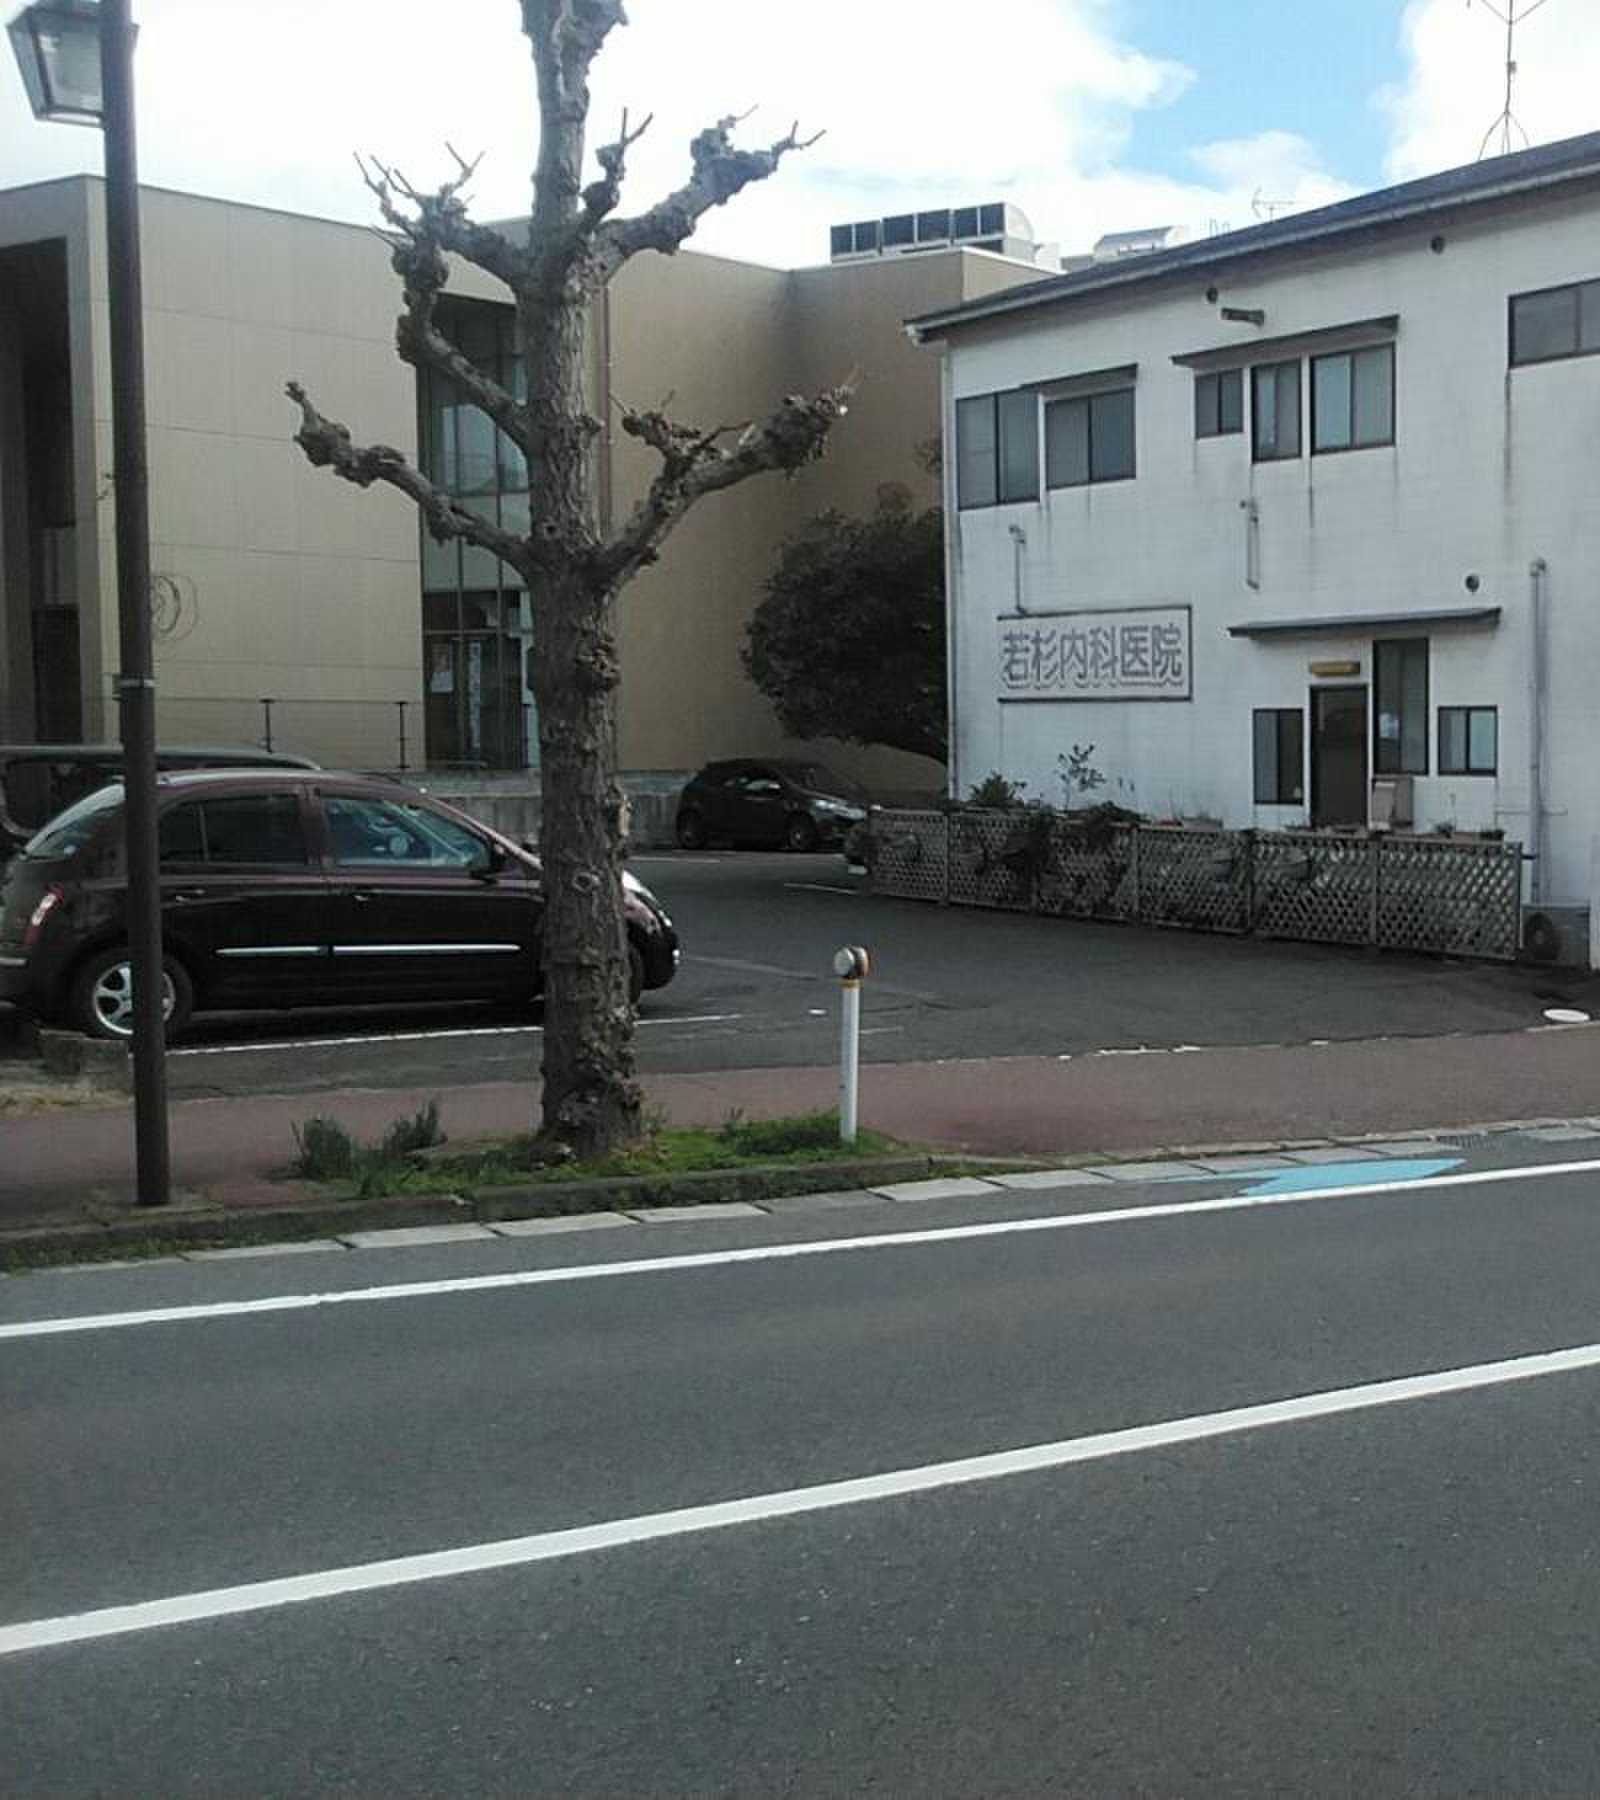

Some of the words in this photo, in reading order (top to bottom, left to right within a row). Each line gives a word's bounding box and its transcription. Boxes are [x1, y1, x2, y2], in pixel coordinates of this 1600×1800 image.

[1001, 622, 1184, 685] 若杉内科医院
